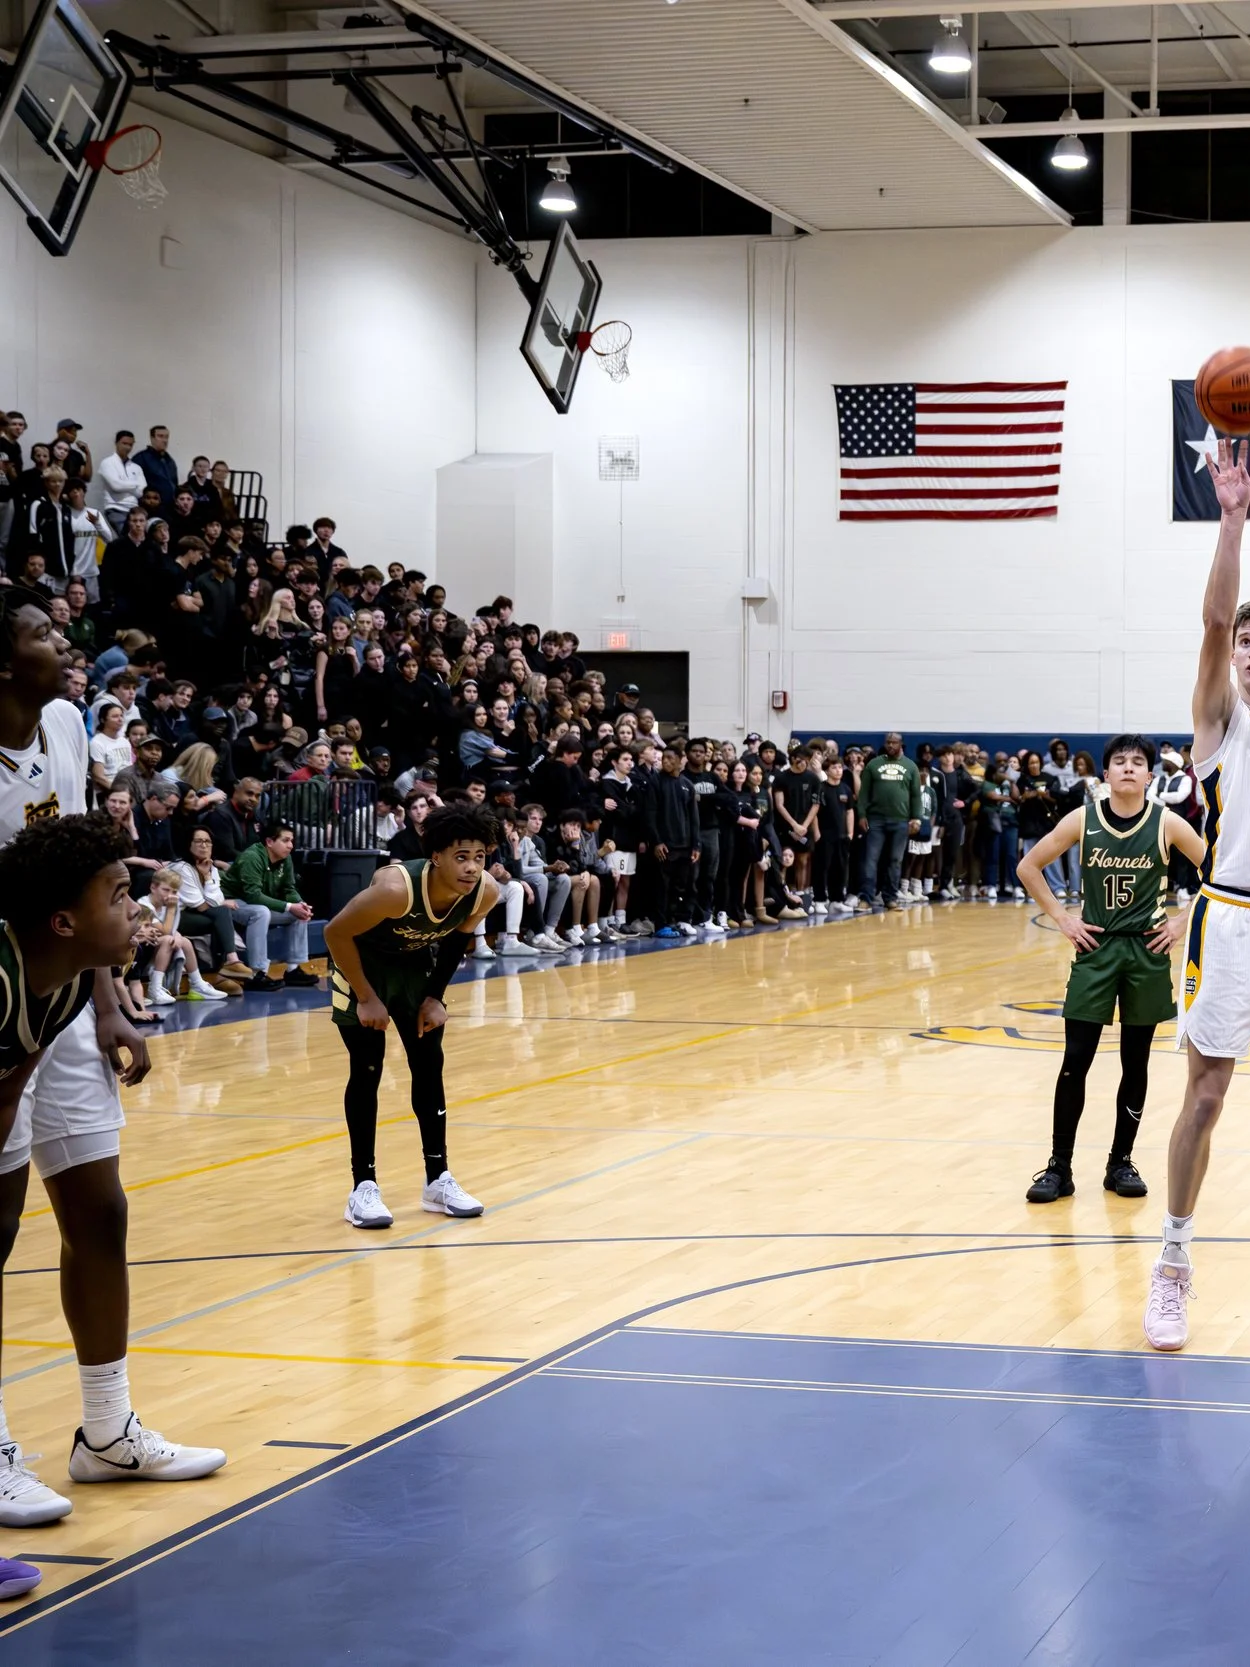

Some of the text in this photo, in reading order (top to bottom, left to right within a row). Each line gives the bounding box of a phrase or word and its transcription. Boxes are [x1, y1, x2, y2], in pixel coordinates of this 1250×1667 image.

[620, 859, 625, 870] 6
[1087, 847, 1155, 869] Hornets
[1103, 874, 1136, 910] 15
